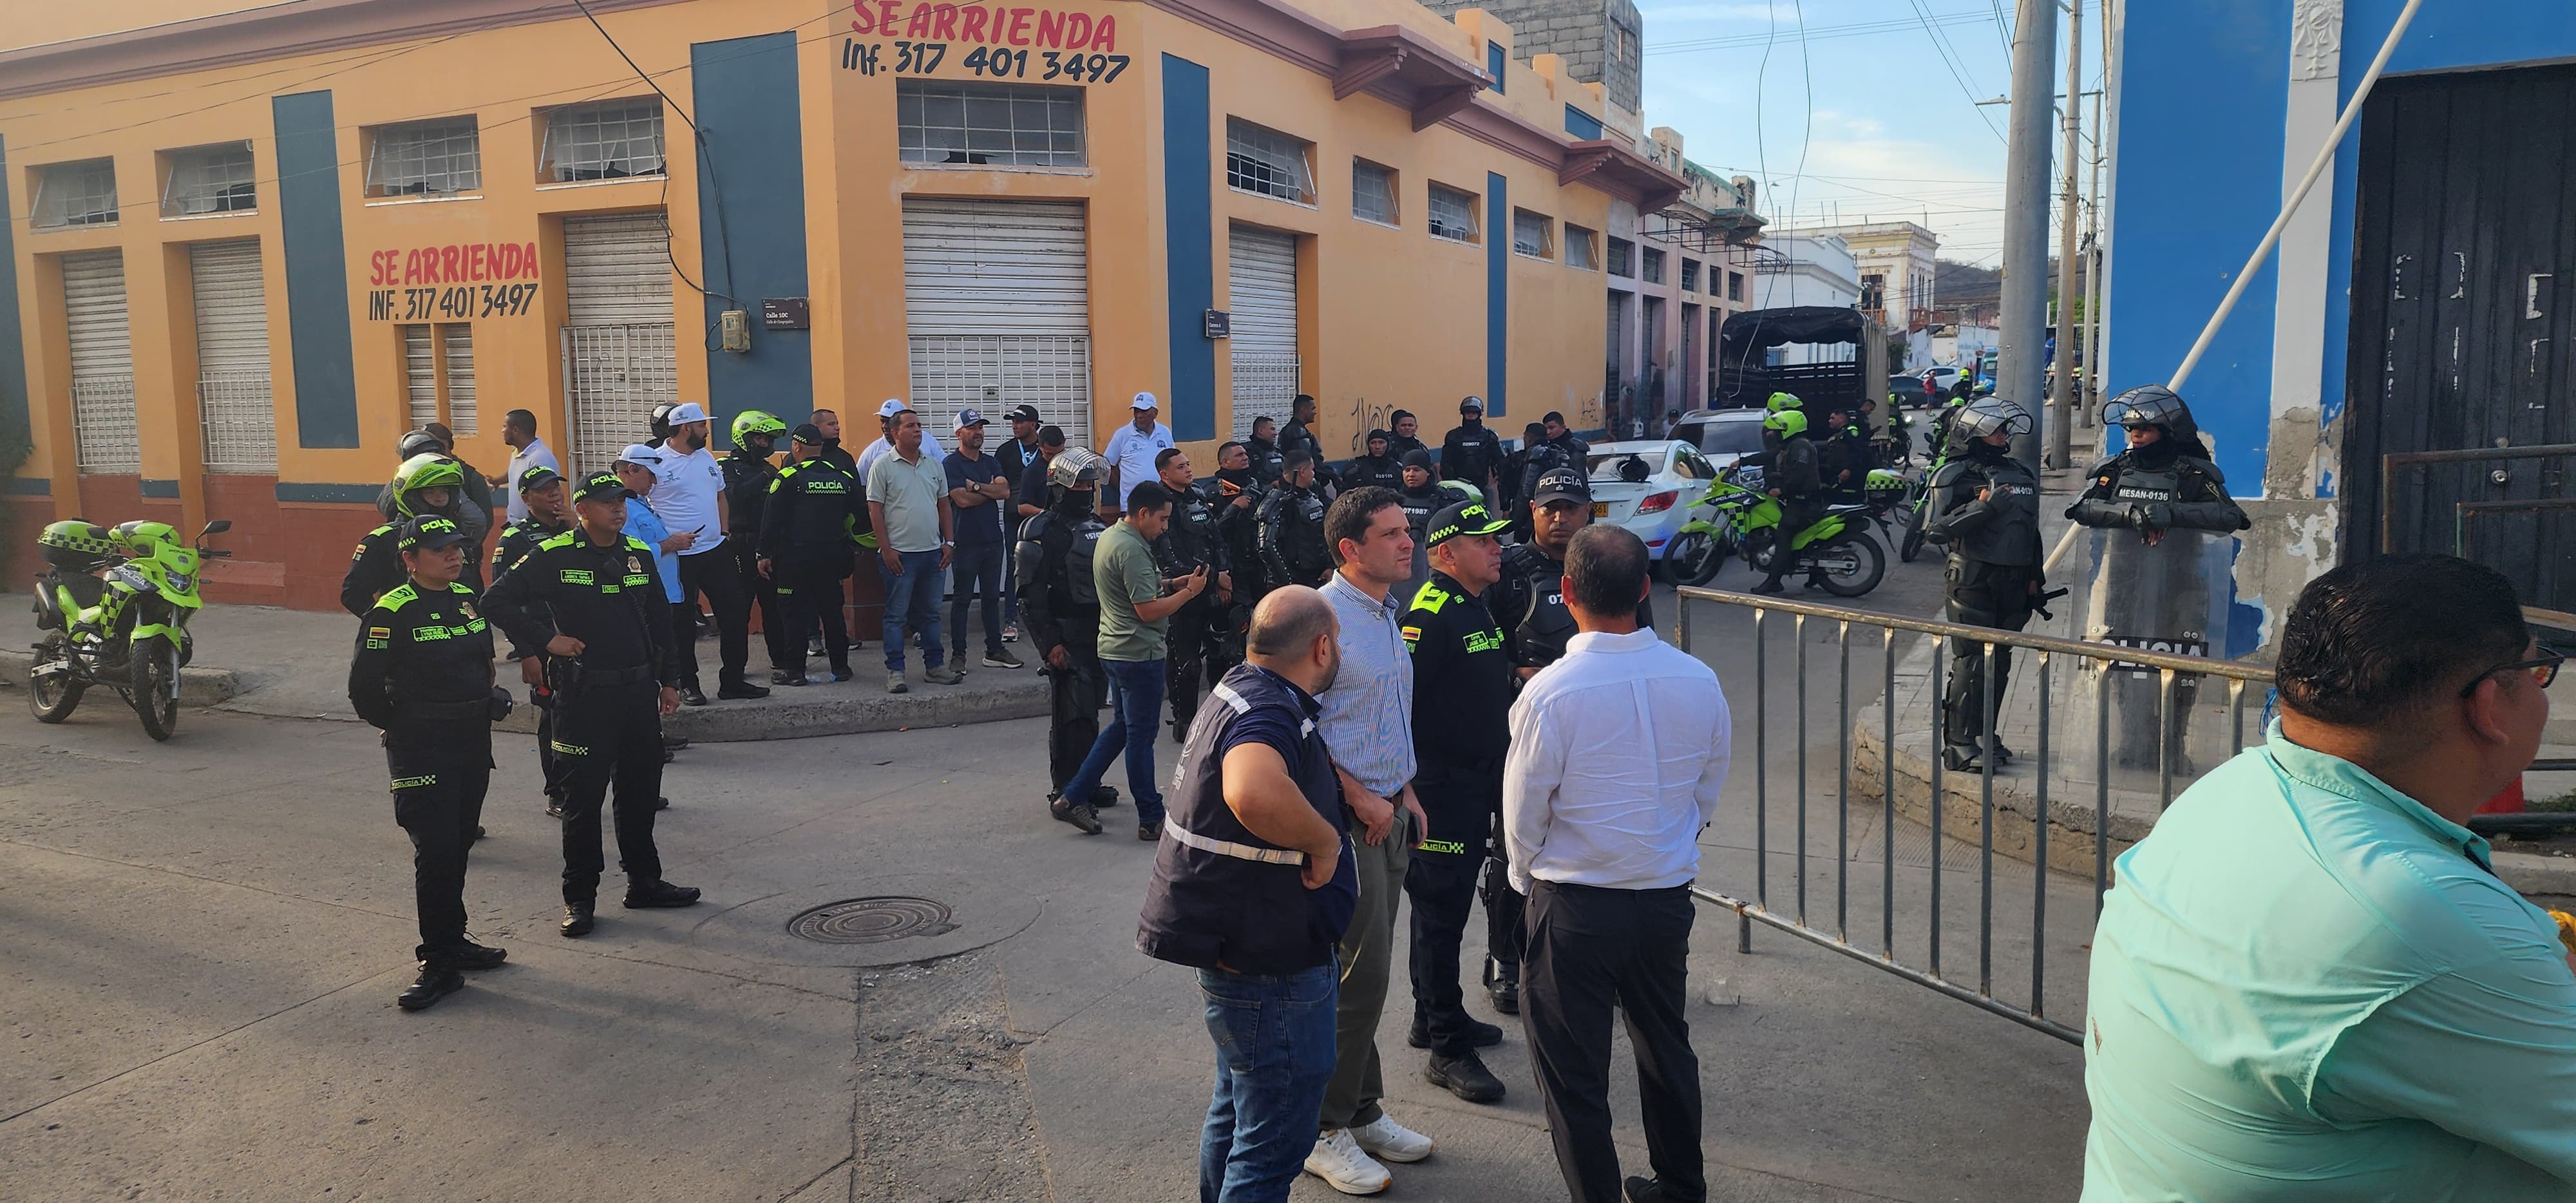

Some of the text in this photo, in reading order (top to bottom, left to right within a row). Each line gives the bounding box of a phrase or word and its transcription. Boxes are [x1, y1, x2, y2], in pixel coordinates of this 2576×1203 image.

[851, 0, 1115, 53] SE ARRIENDA
[895, 41, 947, 74] 317
[963, 46, 1028, 78] 401
[1042, 52, 1130, 84] 3497
[370, 242, 538, 286] SE ARRIENDA
[369, 283, 538, 321] INF. 317 401 3497
[808, 479, 843, 489] POLICÍA
[1539, 475, 1583, 489] POLICÍA
[1715, 492, 1742, 502] POLICÍA
[2119, 488, 2169, 501] MESAN-0136
[120, 567, 145, 587] POLICÍA
